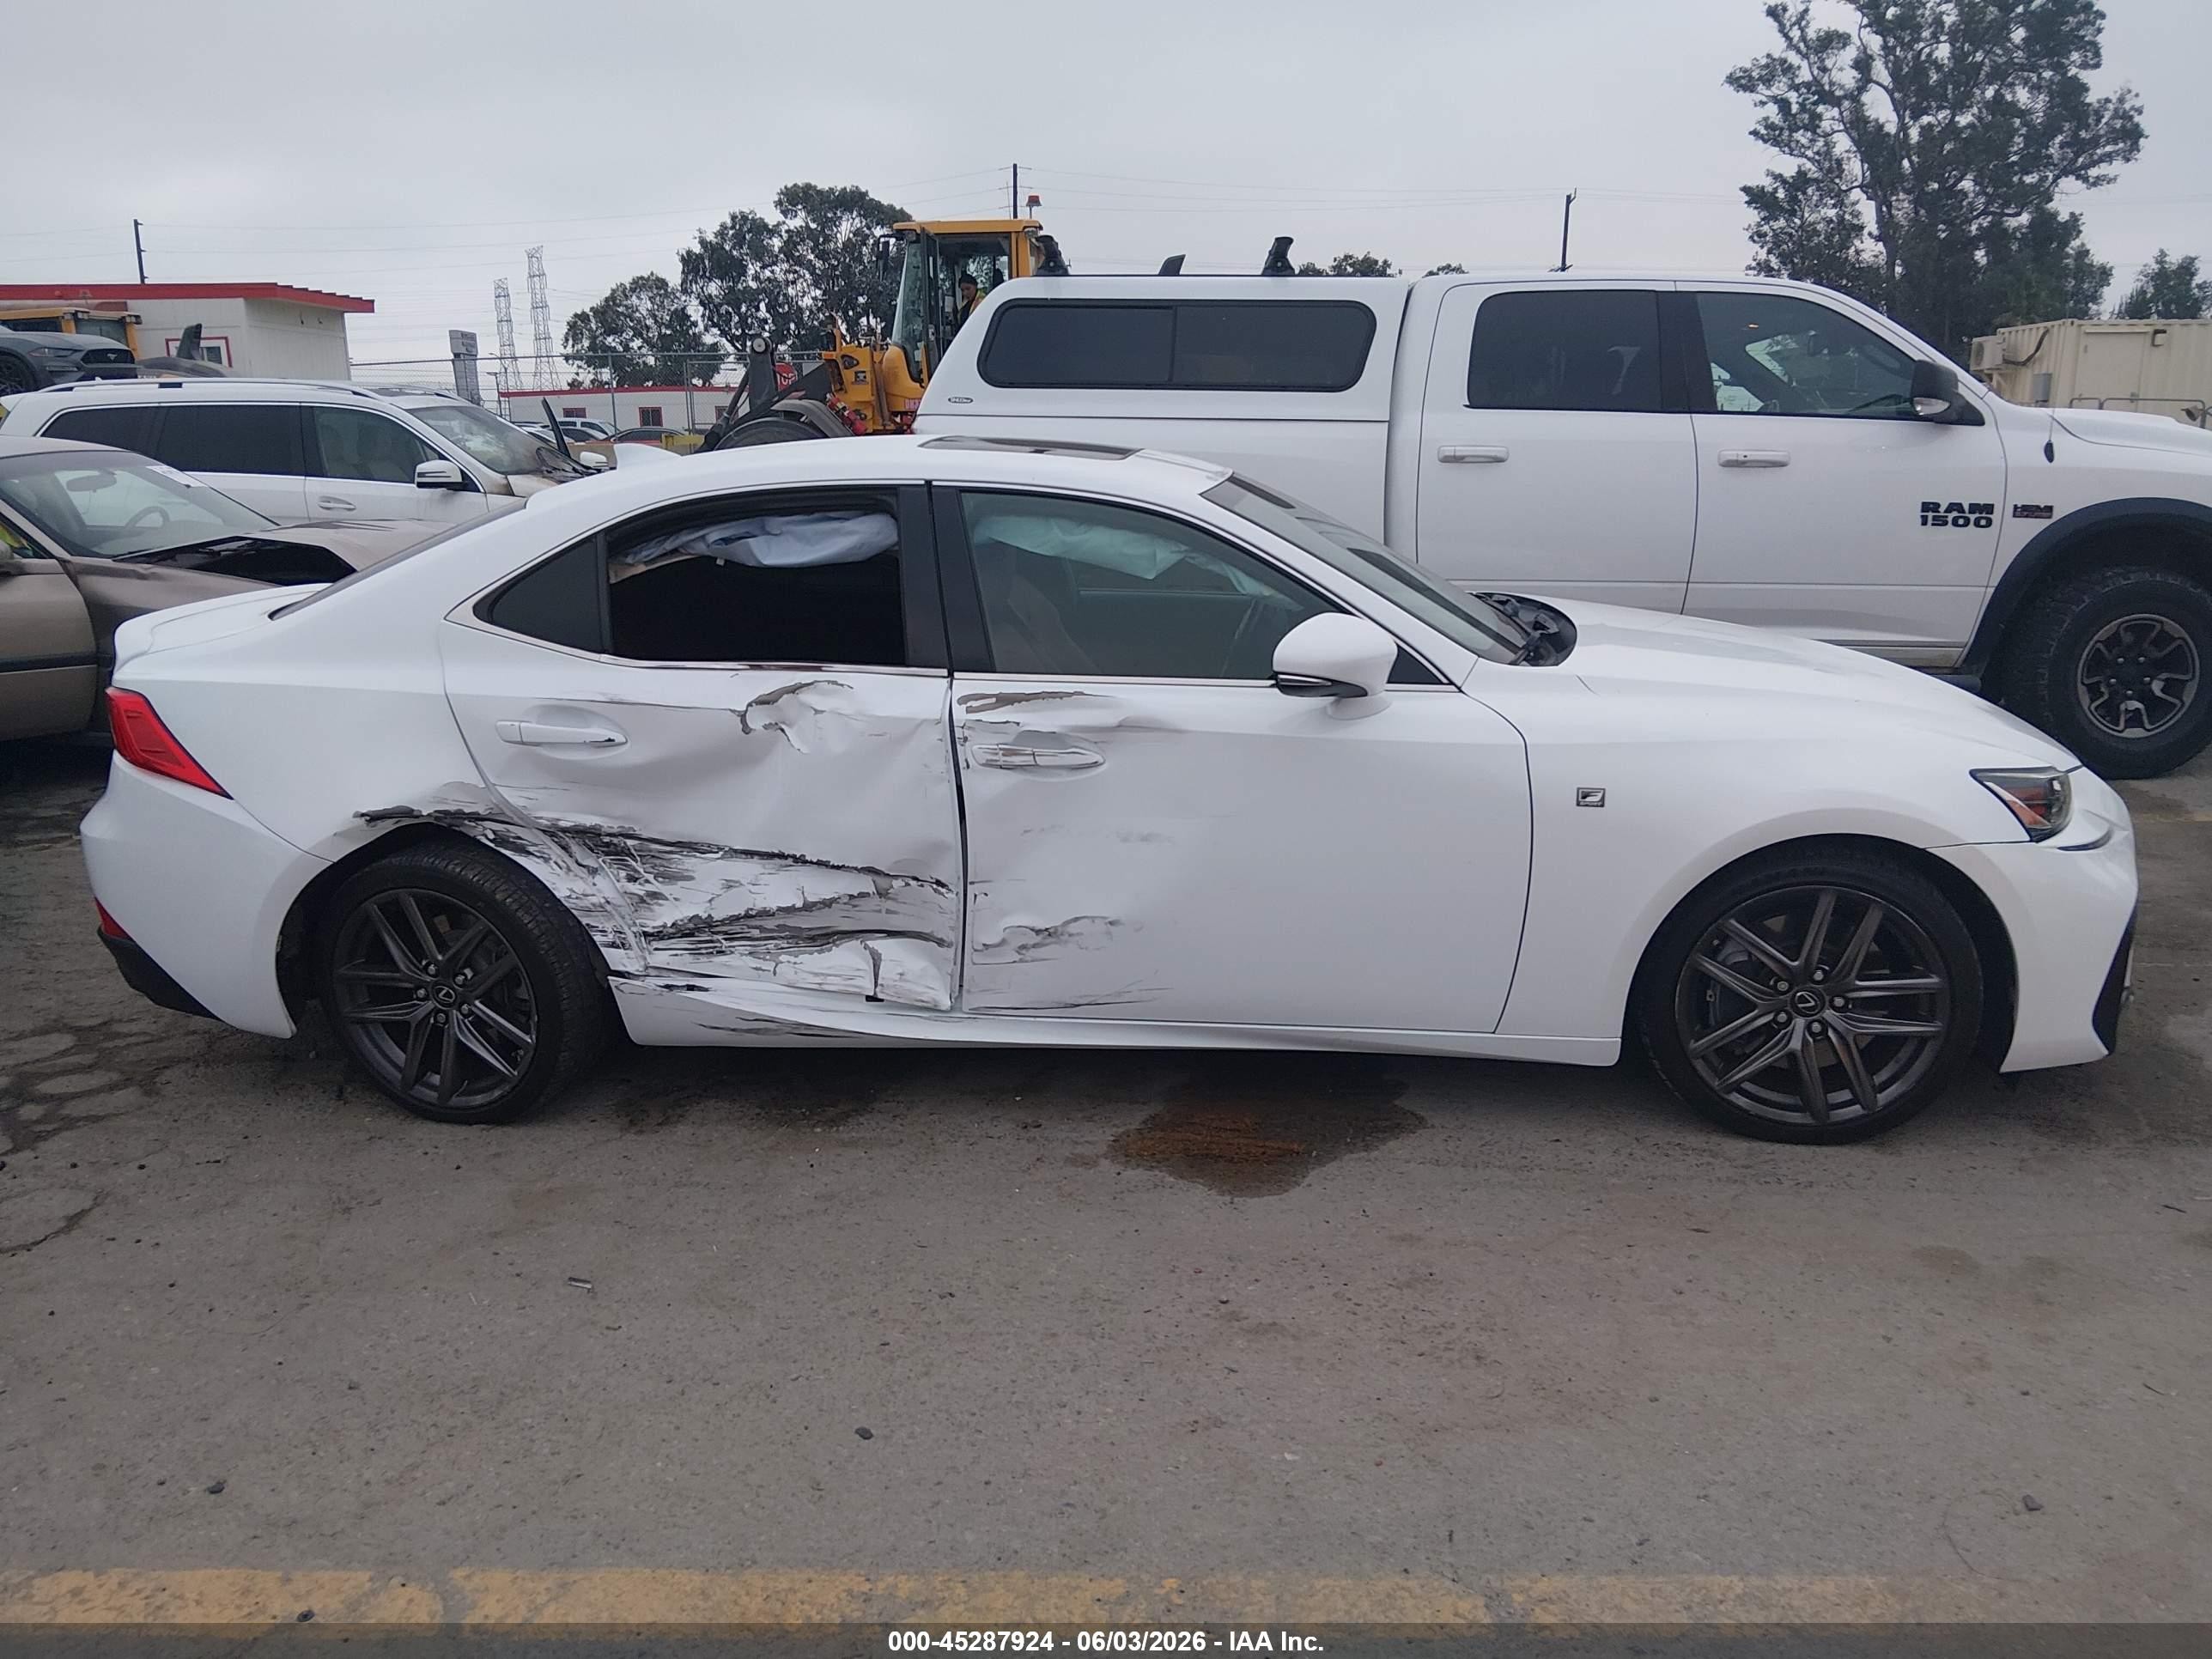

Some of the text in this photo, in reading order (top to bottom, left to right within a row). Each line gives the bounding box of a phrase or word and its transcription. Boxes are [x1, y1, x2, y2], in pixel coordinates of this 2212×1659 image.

[776, 372, 796, 386] TOP
[1920, 501, 1995, 515] RAM
[1920, 514, 1993, 529] 1500
